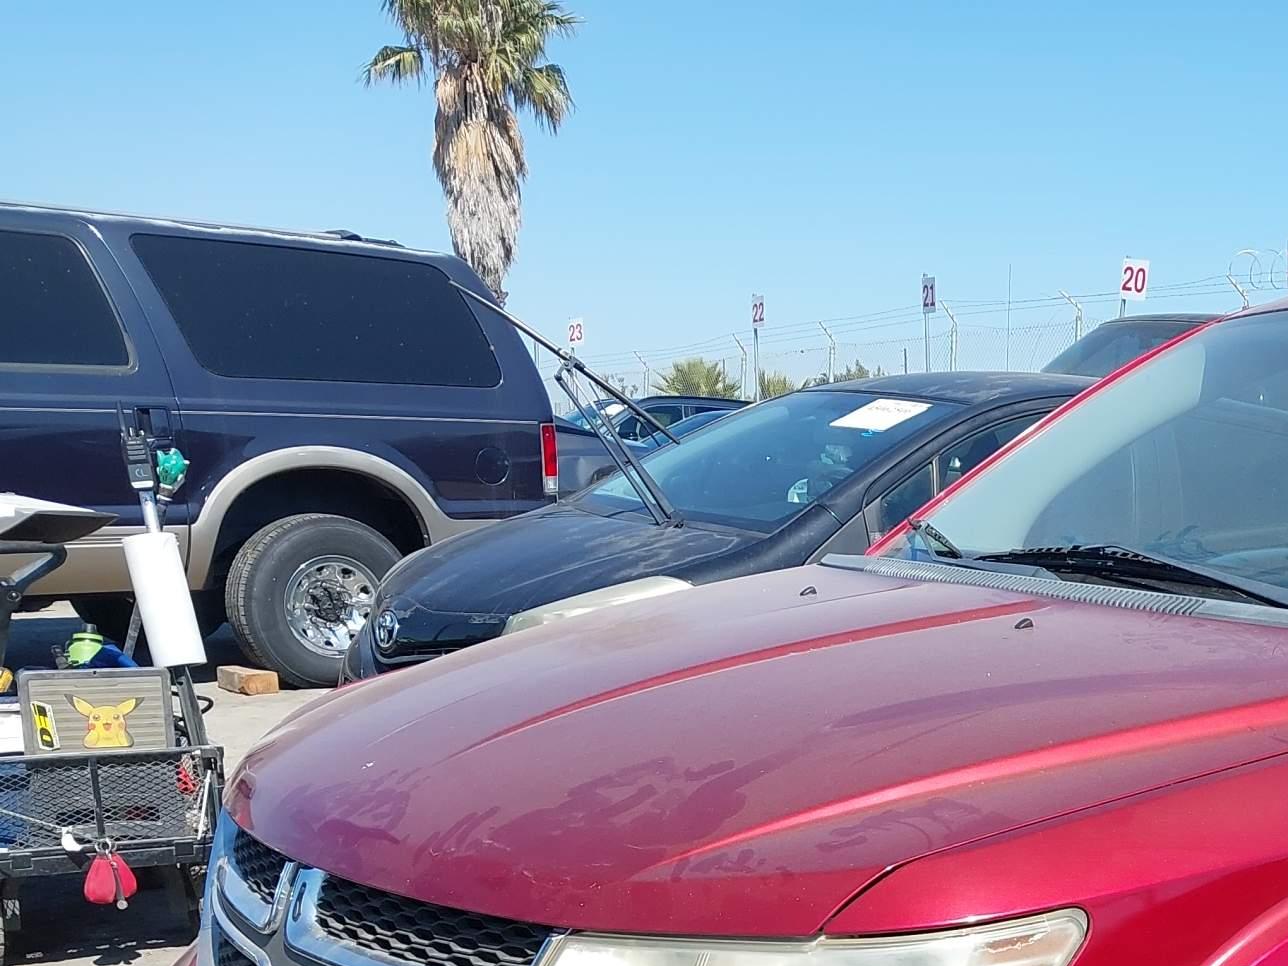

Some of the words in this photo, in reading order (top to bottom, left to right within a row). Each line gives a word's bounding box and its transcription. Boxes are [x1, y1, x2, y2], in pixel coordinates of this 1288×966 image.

[1121, 266, 1146, 293] 20
[922, 284, 936, 307] 21
[752, 302, 765, 323] 22
[568, 323, 583, 342] 23
